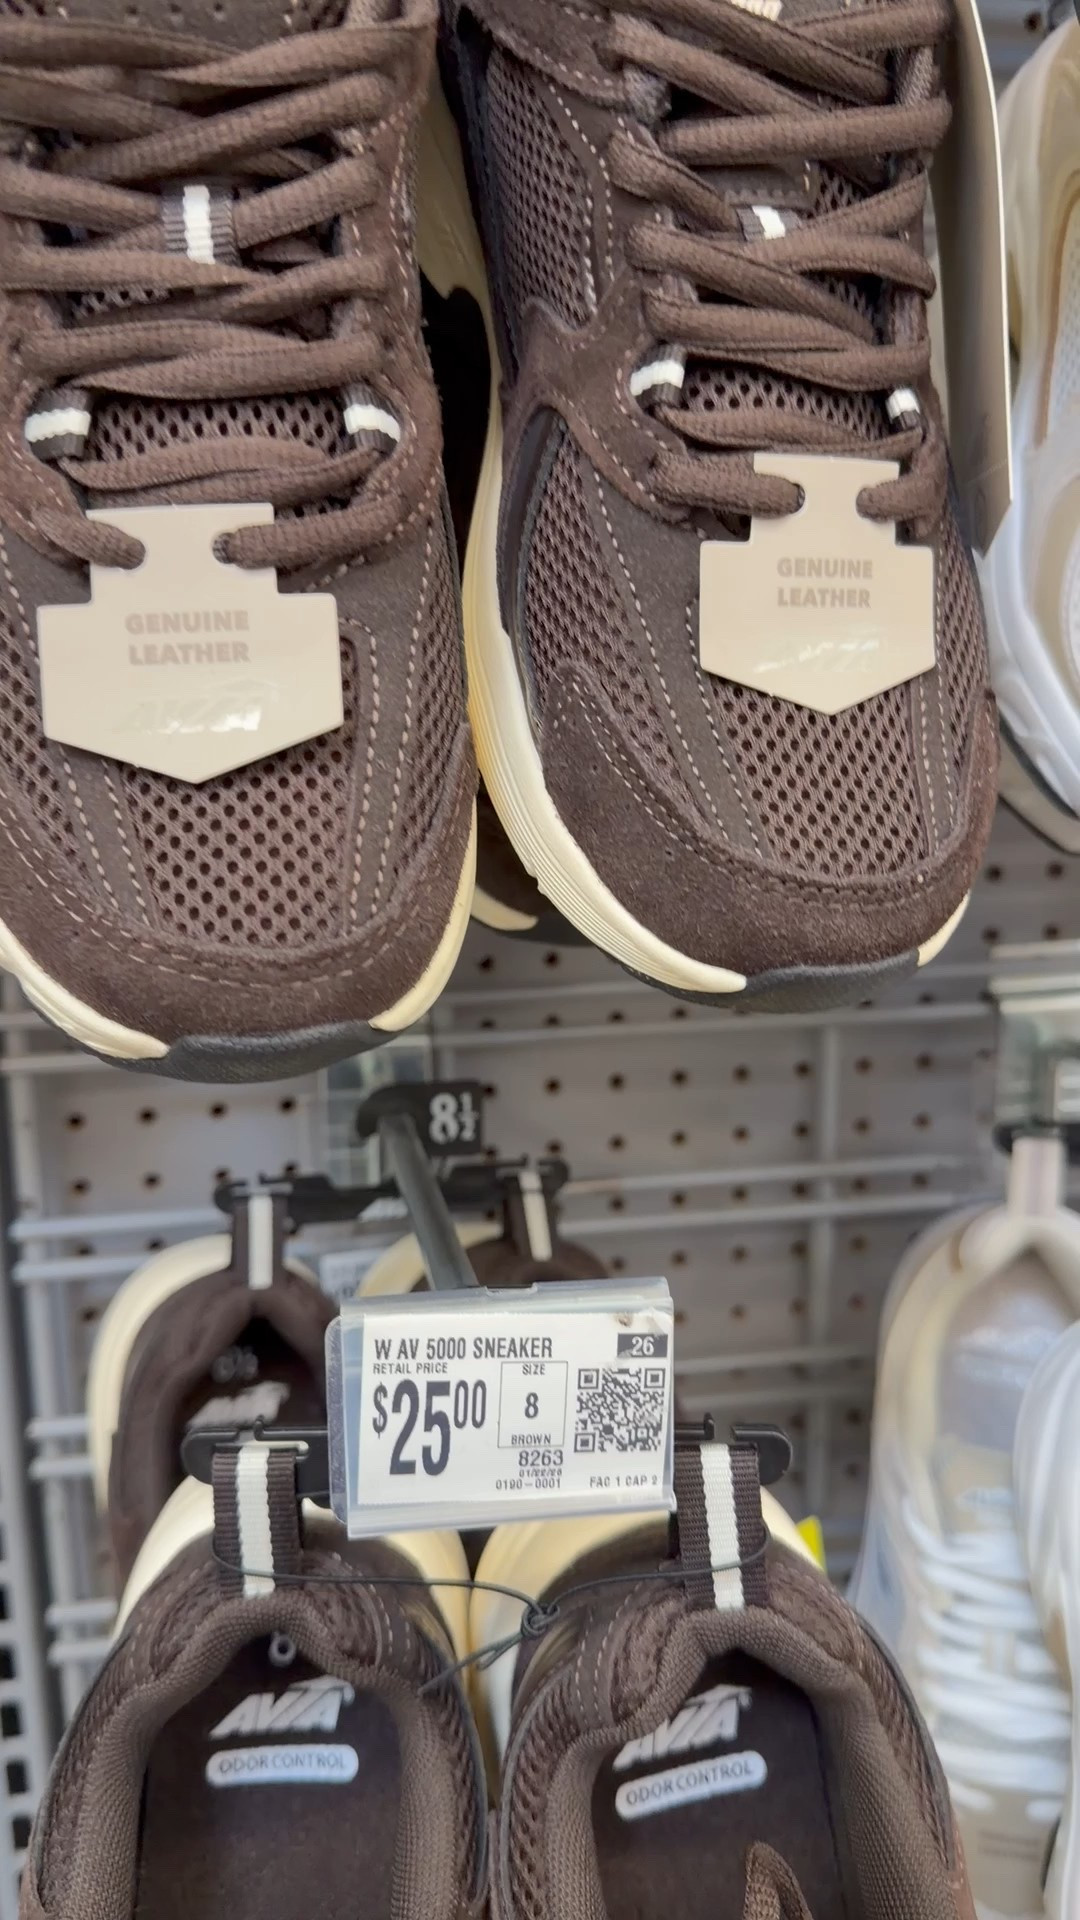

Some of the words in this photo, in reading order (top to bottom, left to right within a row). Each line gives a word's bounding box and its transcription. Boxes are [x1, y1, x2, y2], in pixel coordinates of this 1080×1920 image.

[777, 557, 873, 579] GENUINE
[777, 586, 872, 608] LEATHER
[124, 610, 249, 635] GENUINE
[128, 641, 251, 666] LEATHER
[374, 1339, 392, 1360] W
[397, 1339, 420, 1360] AV
[426, 1337, 466, 1360] 5000
[473, 1336, 553, 1359] SNEAKER
[631, 1336, 655, 1356] 26
[372, 1362, 412, 1375] RETAIL
[416, 1362, 448, 1375] PRICE
[522, 1363, 546, 1375] SIZE
[524, 1392, 539, 1419] 8
[511, 1434, 551, 1445] BROWN
[518, 1449, 564, 1467] 8263
[625, 1474, 648, 1487] CAP
[209, 1674, 356, 1740] AVIA
[219, 1754, 269, 1773] ODOR
[271, 1752, 347, 1769] CONTROL
[625, 1782, 675, 1806] ODOR
[675, 1759, 754, 1791] CONTROL
